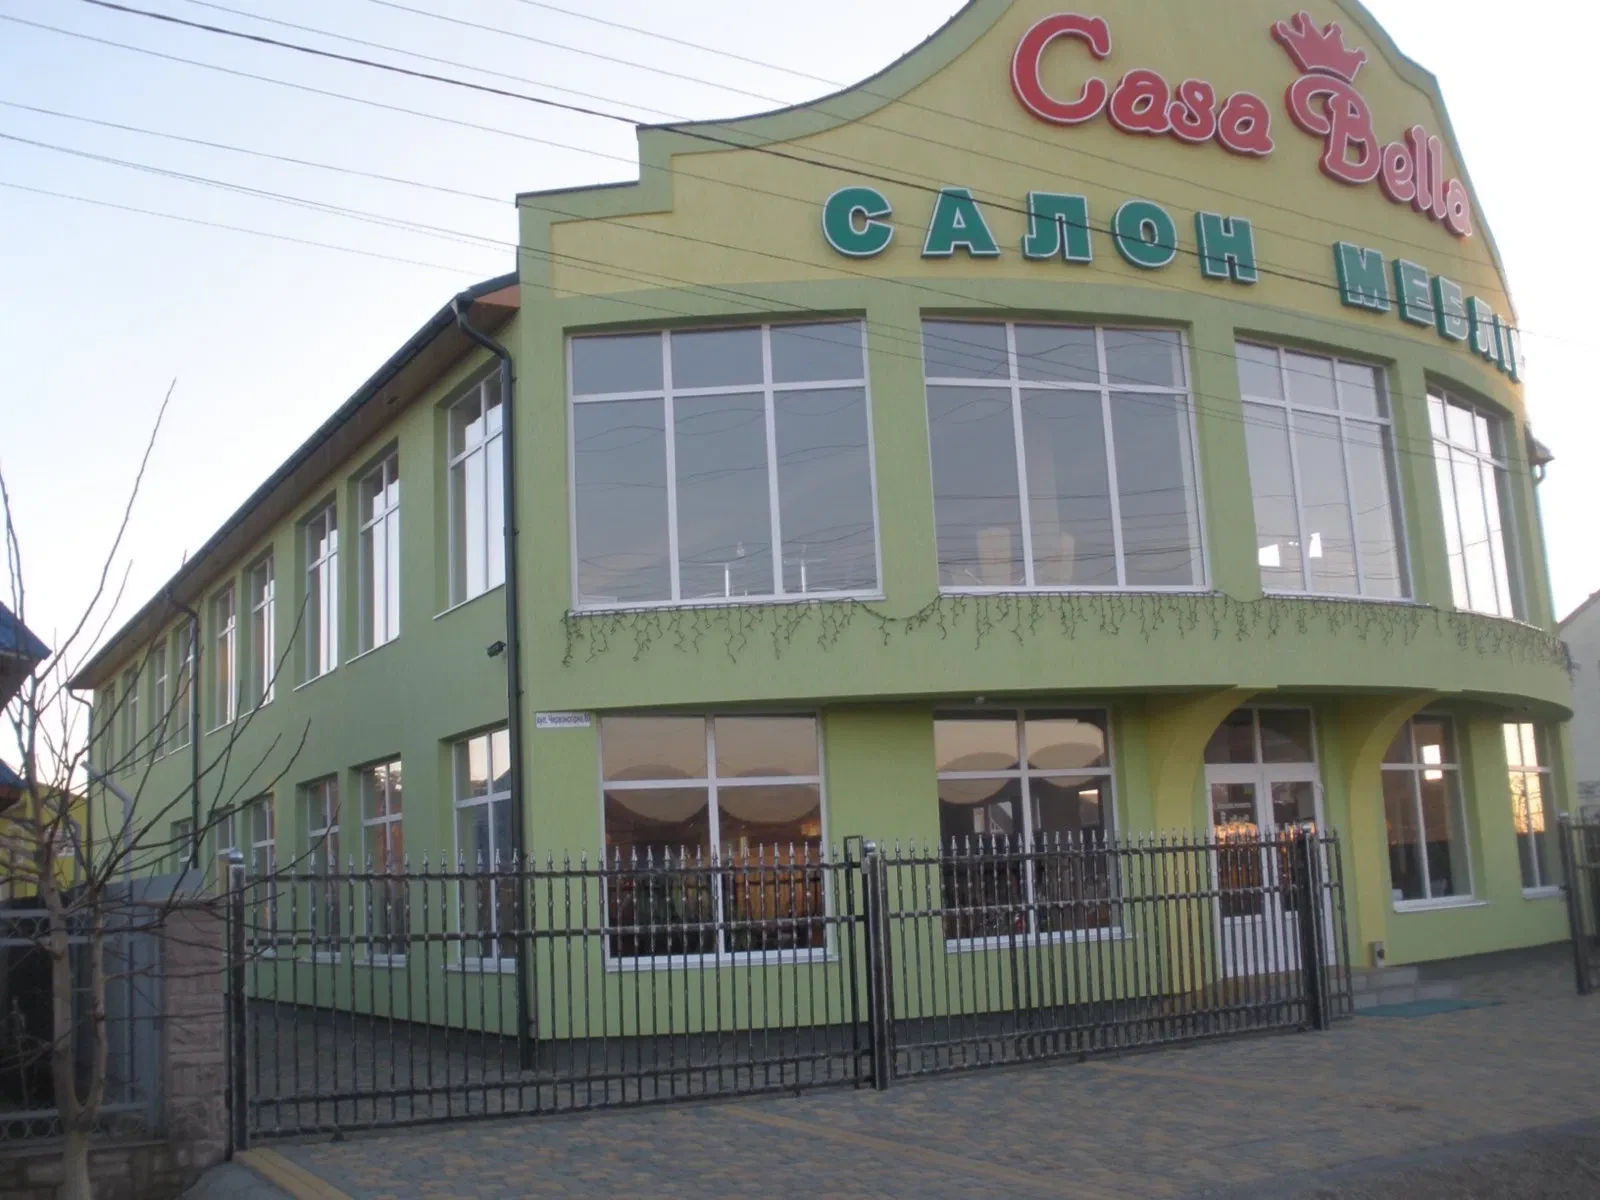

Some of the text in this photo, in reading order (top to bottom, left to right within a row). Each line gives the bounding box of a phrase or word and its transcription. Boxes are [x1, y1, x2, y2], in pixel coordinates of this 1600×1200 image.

[1009, 12, 1473, 237] Casa Bella
[821, 186, 1258, 286] САЛОН
